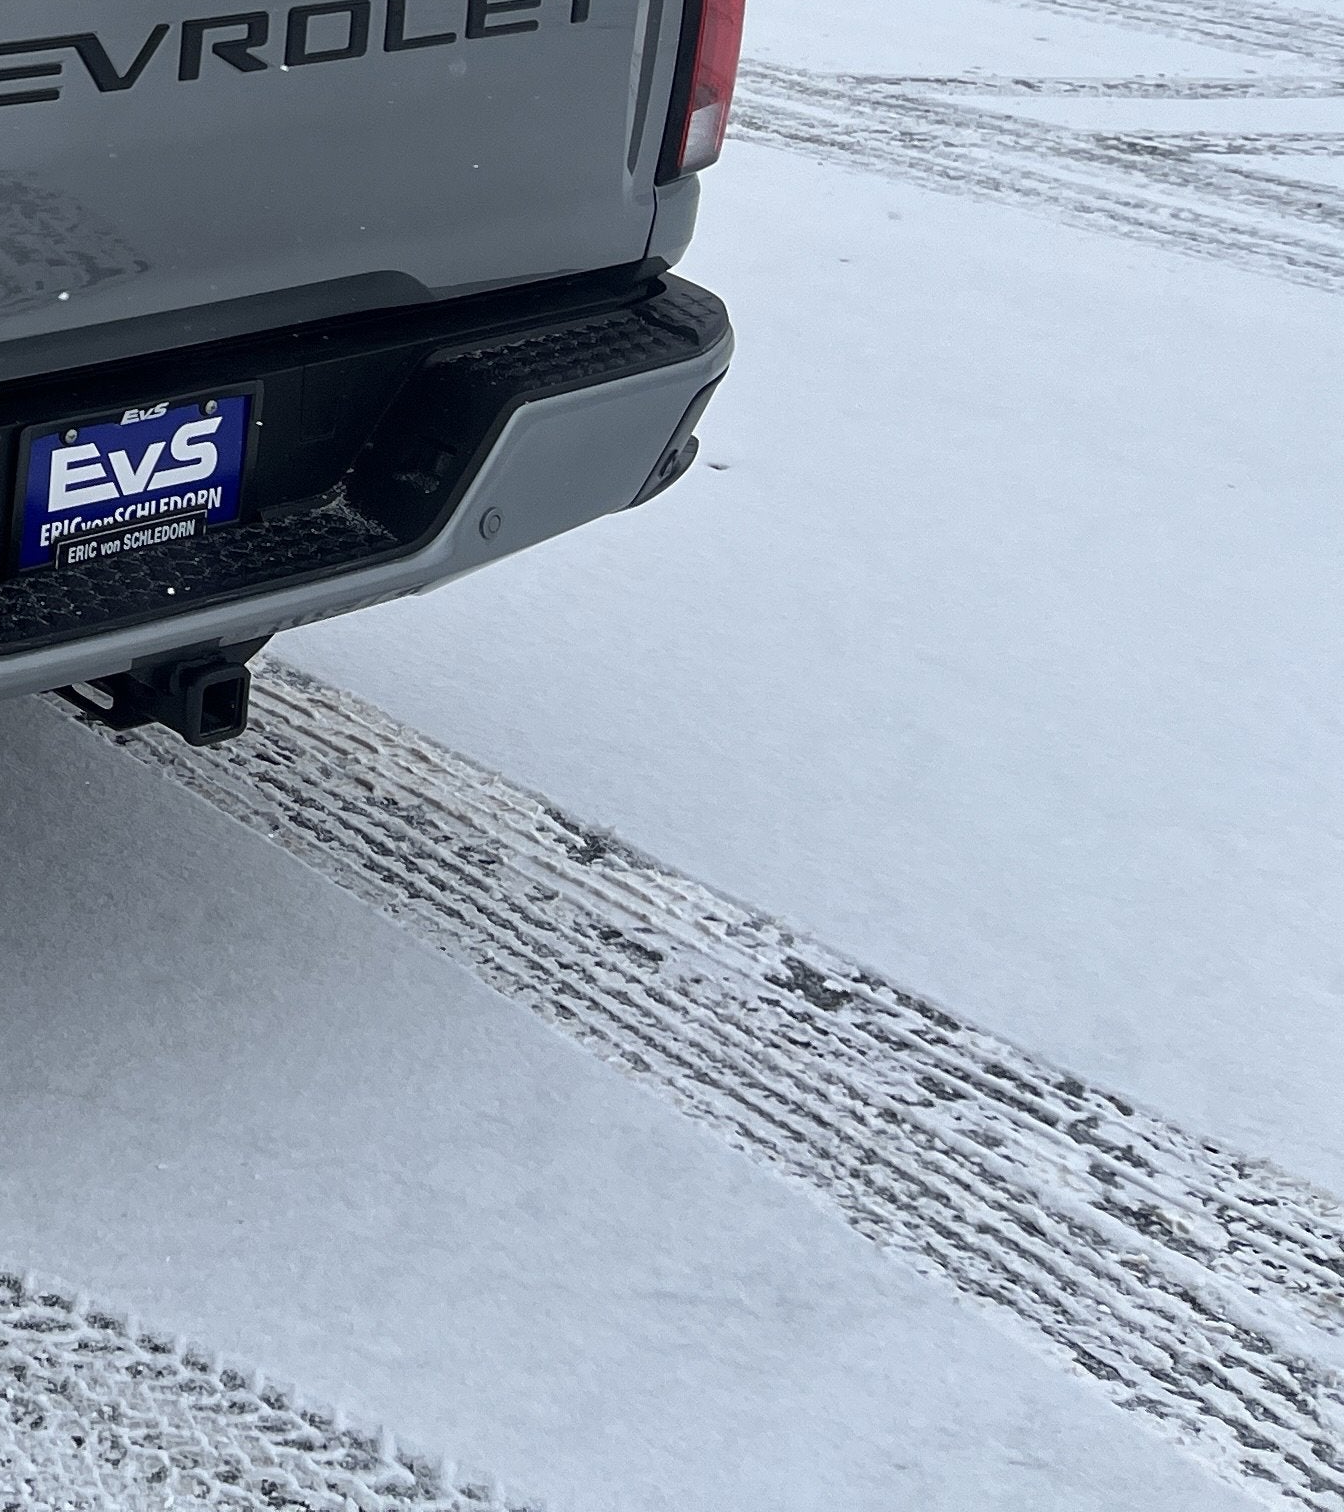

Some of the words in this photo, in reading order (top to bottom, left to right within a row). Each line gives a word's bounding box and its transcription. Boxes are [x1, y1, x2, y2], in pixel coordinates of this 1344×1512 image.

[67, 540, 98, 564] ERIC
[100, 540, 121, 557] von
[122, 518, 197, 551] SCHLEDORN
